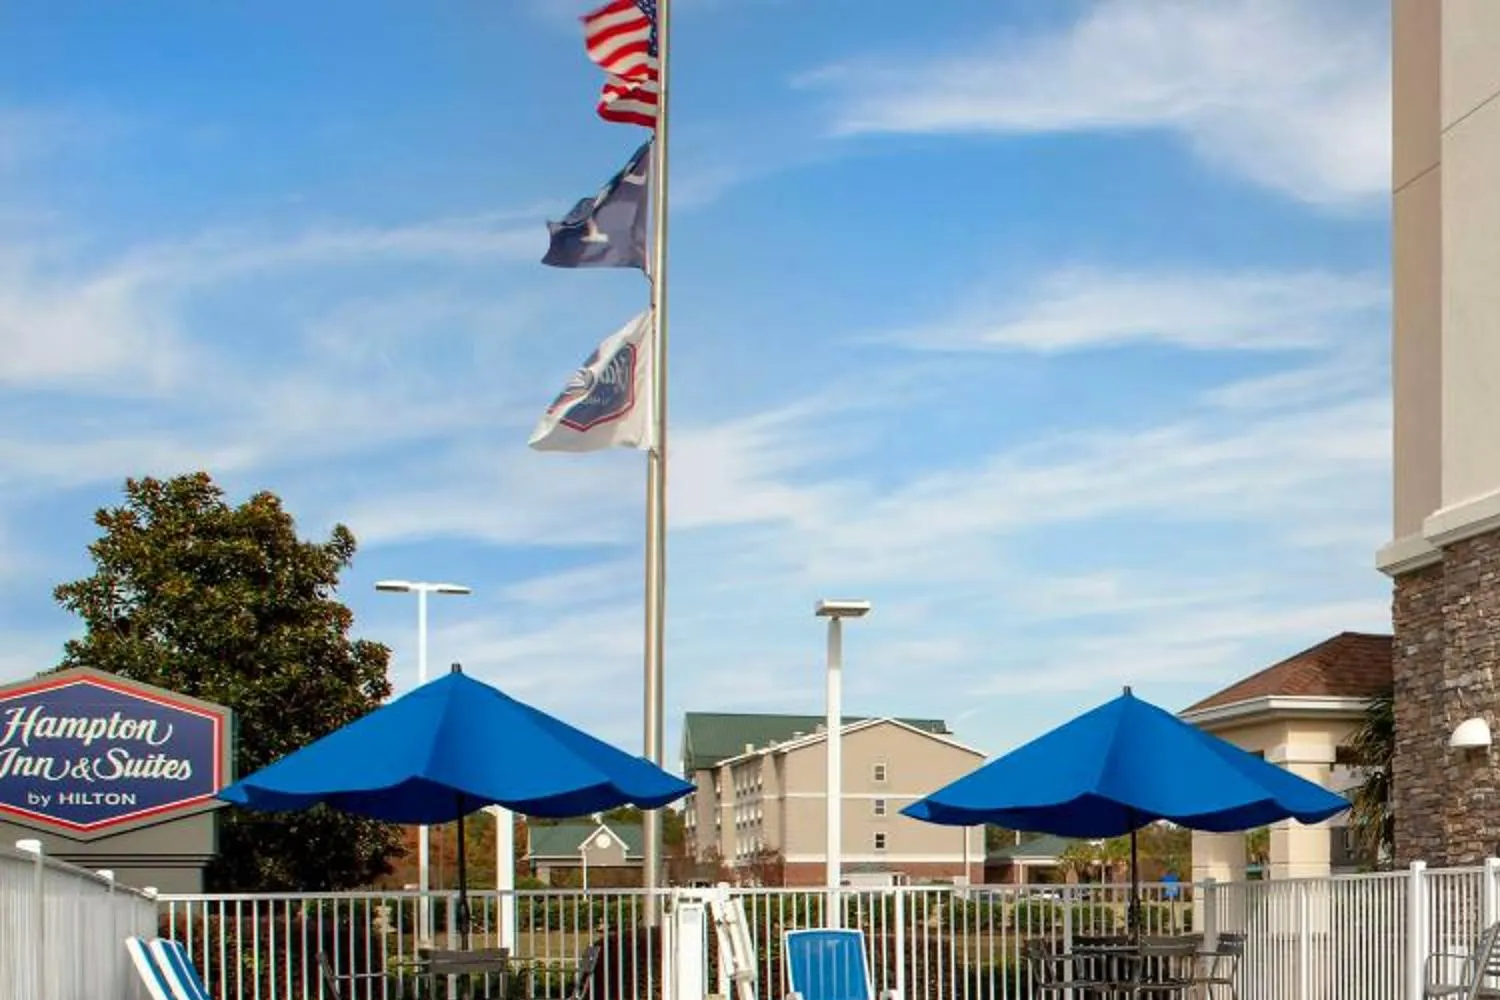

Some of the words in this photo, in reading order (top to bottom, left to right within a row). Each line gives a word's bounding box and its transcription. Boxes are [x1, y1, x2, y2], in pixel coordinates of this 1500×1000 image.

[0, 705, 173, 747] Hampton
[0, 747, 70, 781] Inn
[71, 757, 95, 782] &
[93, 748, 193, 781] Suites
[27, 792, 51, 808] by
[58, 793, 137, 806] HILTON
